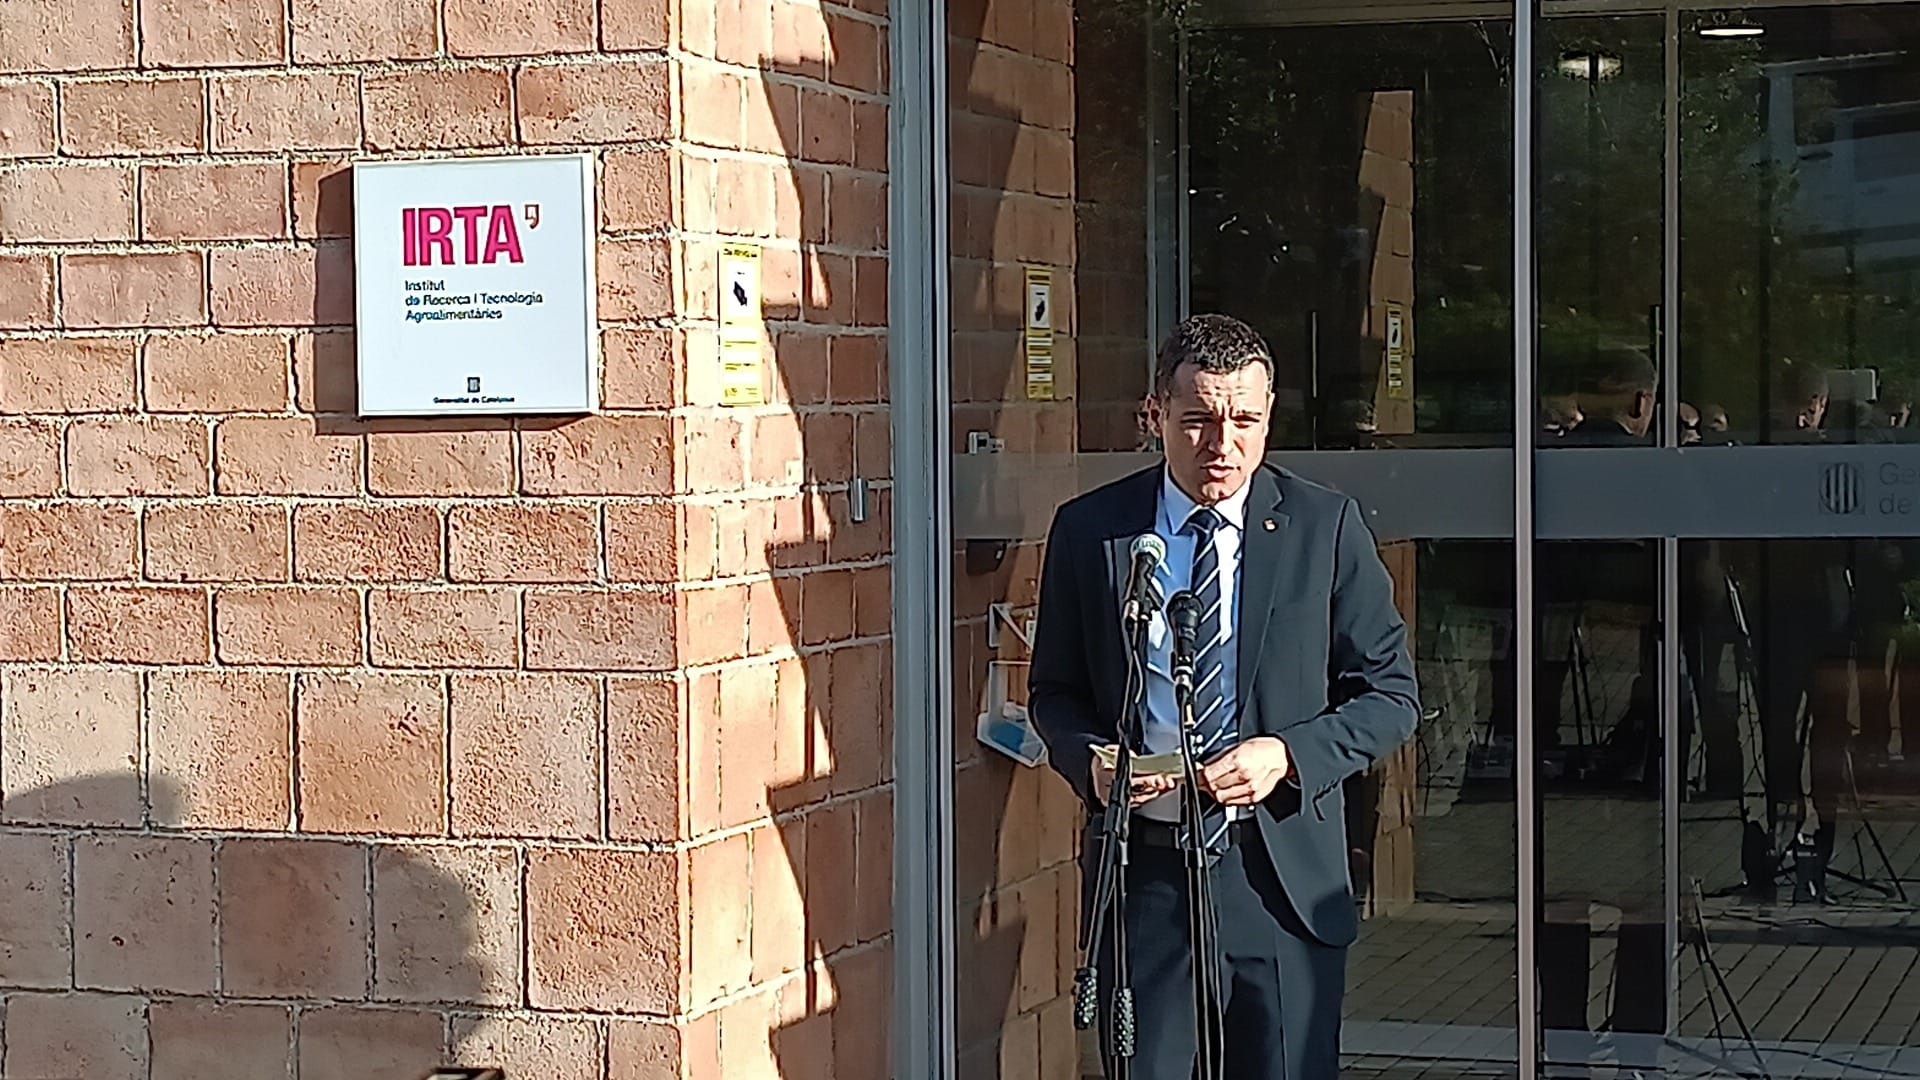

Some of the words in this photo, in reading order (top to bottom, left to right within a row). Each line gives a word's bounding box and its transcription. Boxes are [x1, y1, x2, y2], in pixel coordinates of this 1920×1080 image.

[405, 280, 445, 291] Institut
[405, 295, 420, 306] de
[423, 294, 471, 305] Recerca
[480, 291, 543, 305] Tecnologia
